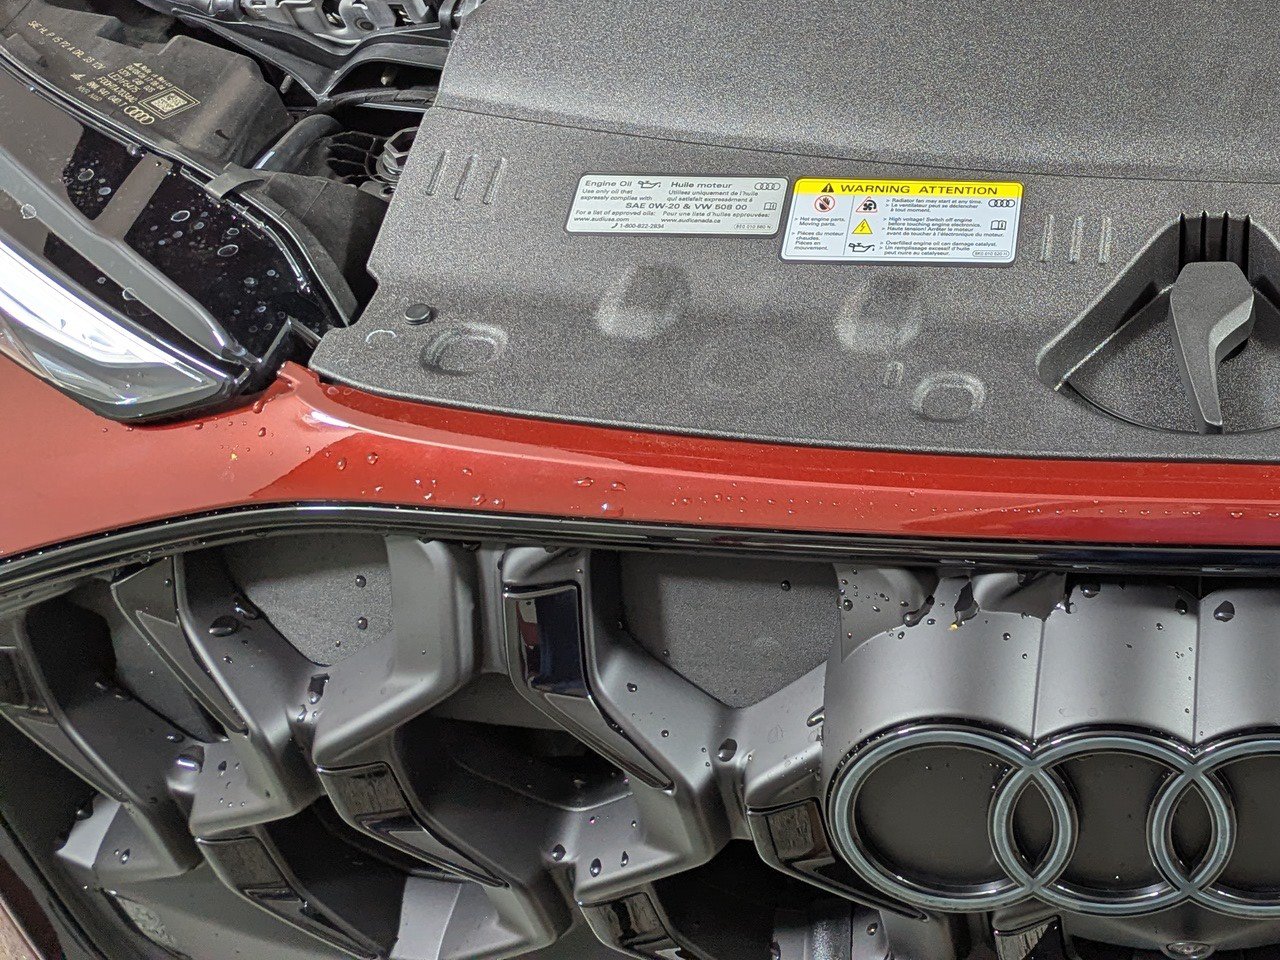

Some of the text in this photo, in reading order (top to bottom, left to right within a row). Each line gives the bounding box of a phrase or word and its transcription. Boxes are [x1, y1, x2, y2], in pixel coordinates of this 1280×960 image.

[585, 180, 616, 188] Engine
[841, 184, 998, 195] WARNING ATTENTION
[715, 203, 733, 211] 508
